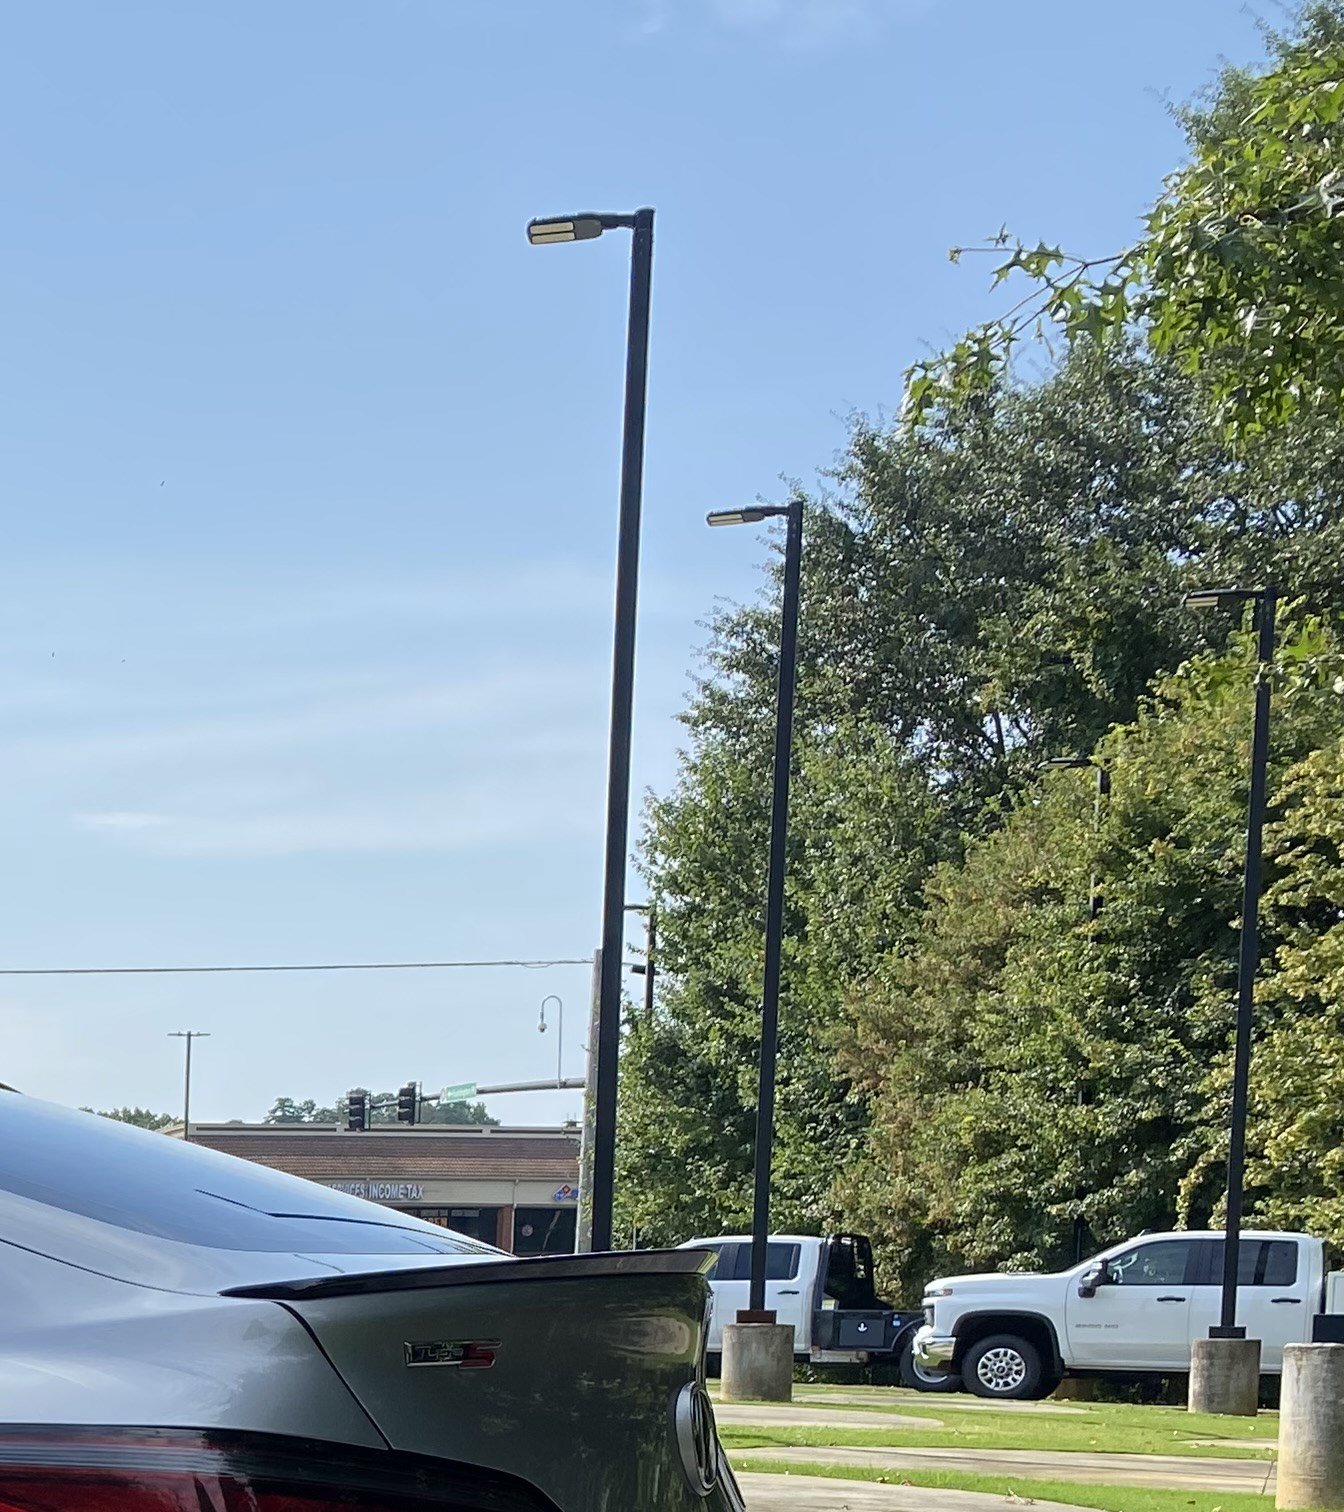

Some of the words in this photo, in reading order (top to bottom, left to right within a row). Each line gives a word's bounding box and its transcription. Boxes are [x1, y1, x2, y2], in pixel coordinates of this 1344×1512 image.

[328, 1183, 366, 1199] VICES
[368, 1183, 404, 1199] INCOME
[406, 1183, 424, 1199] TAX
[459, 1340, 503, 1369] S
